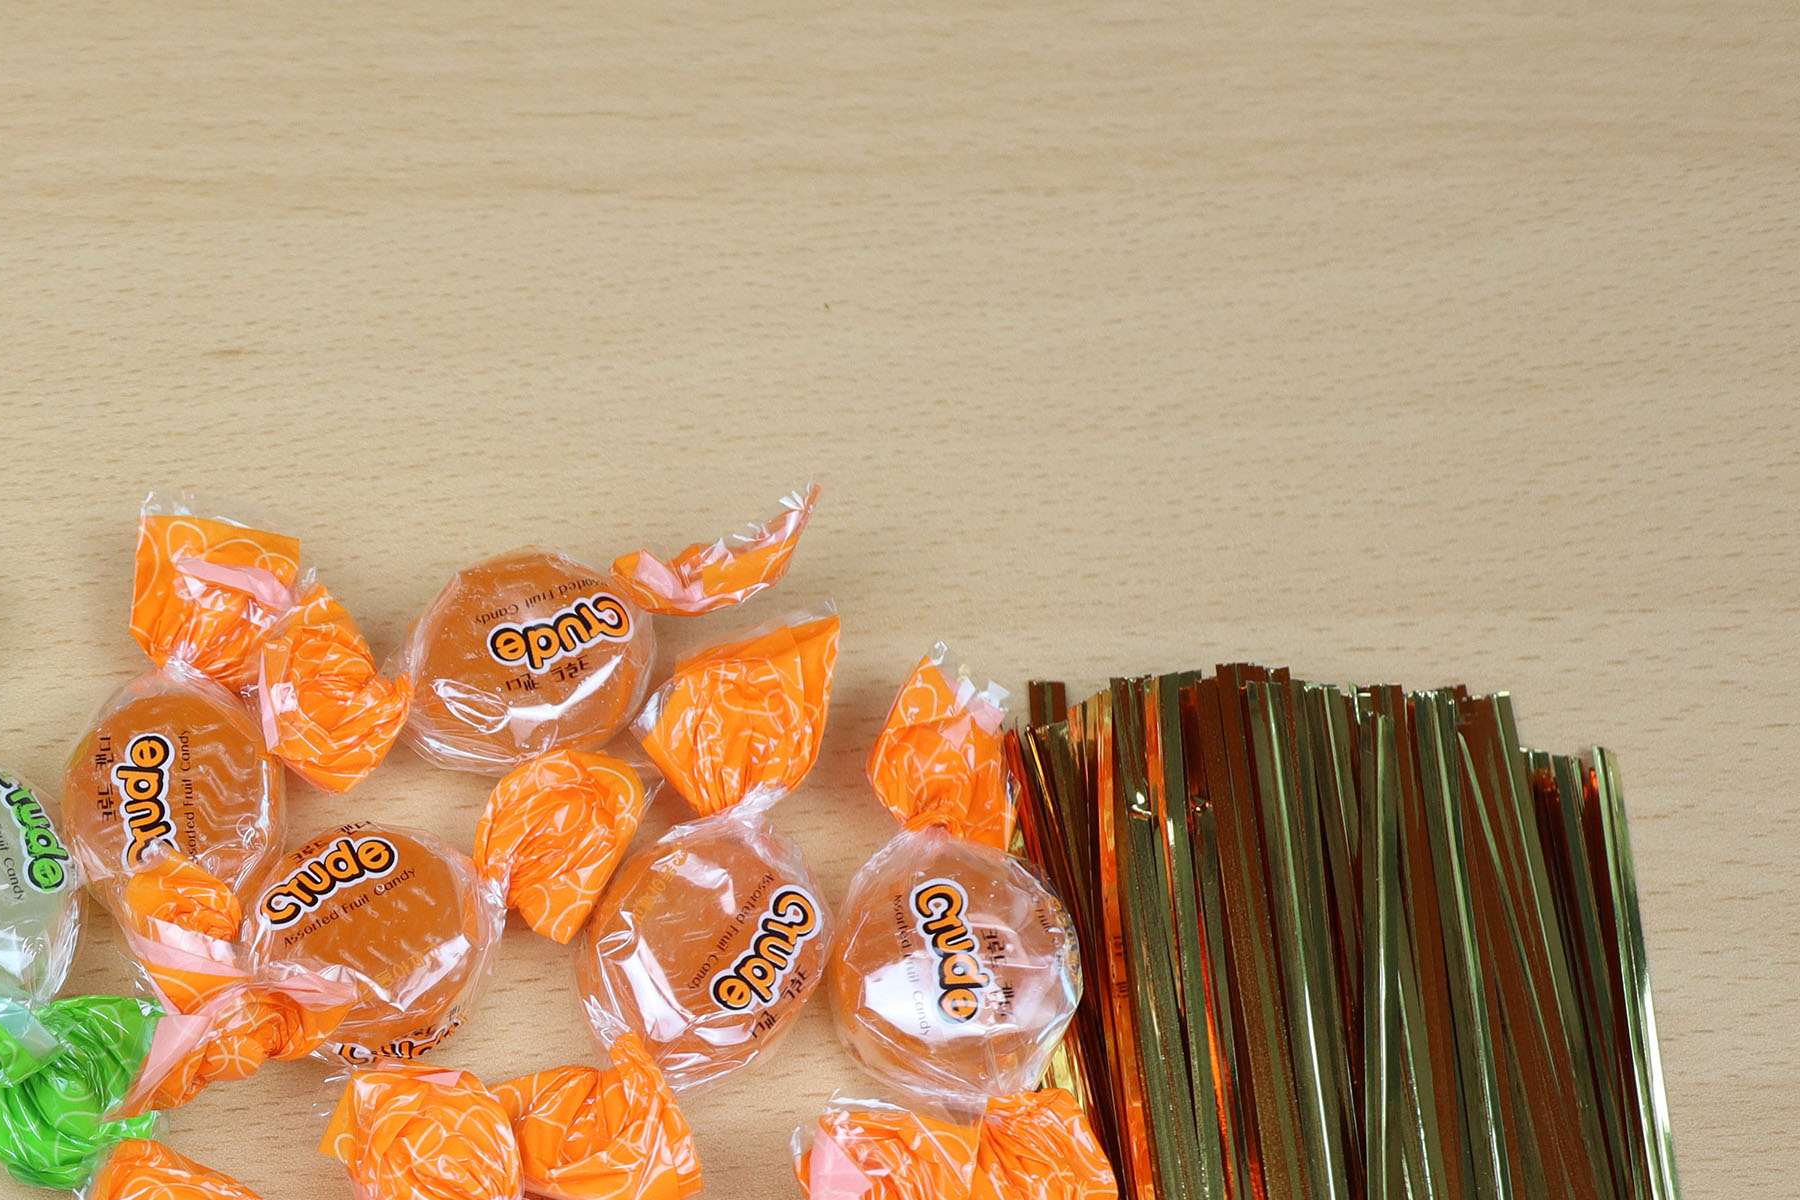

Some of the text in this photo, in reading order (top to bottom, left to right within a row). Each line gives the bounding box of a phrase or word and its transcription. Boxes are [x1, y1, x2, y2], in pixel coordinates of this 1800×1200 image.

[474, 603, 520, 625] Candy
[523, 589, 555, 610] Fruit
[490, 596, 630, 670] Crude
[505, 654, 593, 692] 크루드 캔디
[178, 729, 192, 773] Candy
[95, 736, 117, 824] 크루드 캔디
[181, 778, 194, 808] Fruit
[288, 819, 372, 865] 크루드 캔디
[2, 856, 26, 902] Candy
[260, 837, 396, 925] Crude
[282, 866, 417, 949] Assorted Fruit Candy
[687, 871, 776, 991] Assorted Fruit Candy
[712, 889, 816, 1011] Crude
[915, 883, 991, 1022] Crude
[981, 928, 1008, 969] 크루드
[782, 966, 809, 1002] 크루드
[893, 893, 913, 951] Assorted
[911, 989, 932, 1038] Candy
